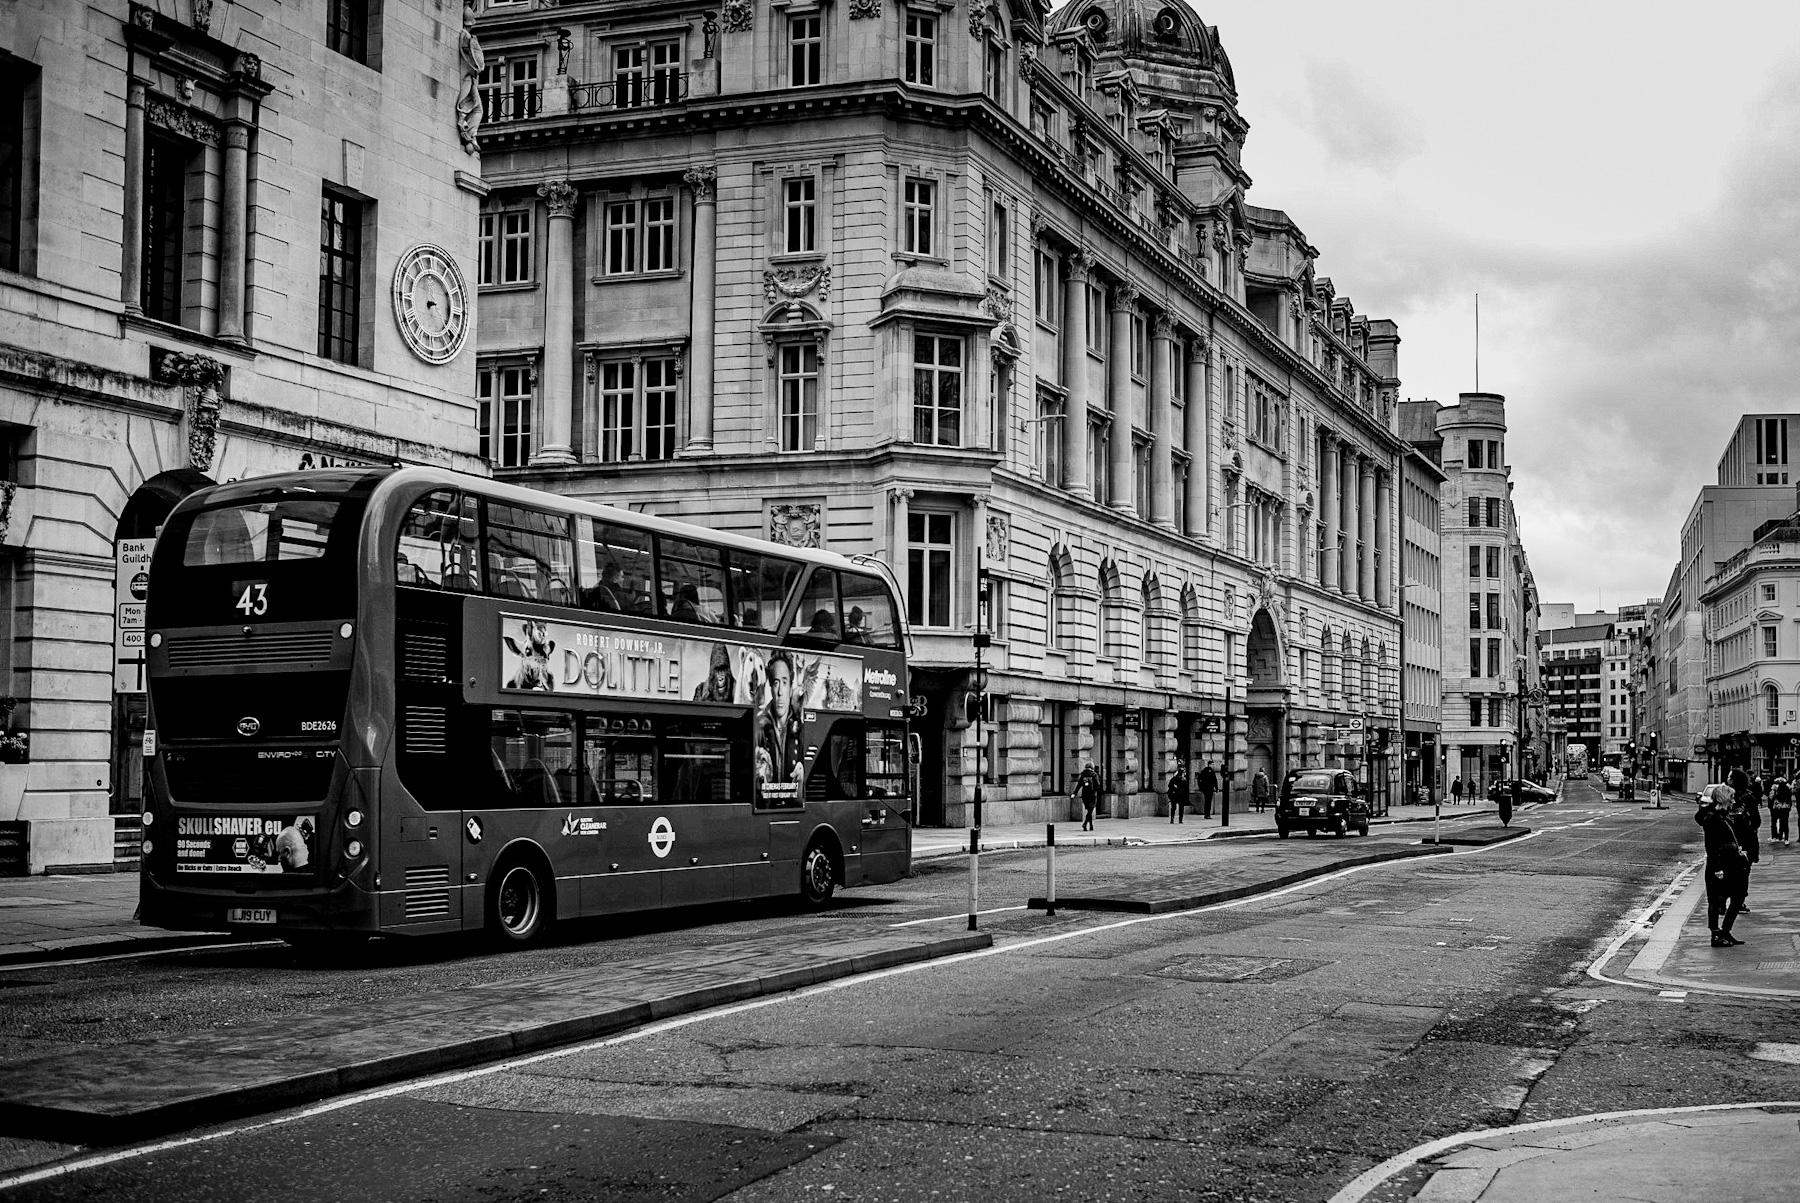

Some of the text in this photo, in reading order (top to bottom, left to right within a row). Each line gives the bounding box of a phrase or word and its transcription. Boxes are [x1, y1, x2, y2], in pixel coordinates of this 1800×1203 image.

[122, 542, 146, 552] Bank
[236, 584, 268, 616] 43
[576, 633, 666, 655] ROBERT DOWNEY JR.
[562, 647, 679, 694] DOLITTLE
[864, 668, 897, 686] Metroline
[301, 720, 337, 731] BDE2626
[178, 818, 282, 835] SKULLSHAVER eu
[177, 840, 212, 849] 90 Seconds
[177, 849, 188, 858] and
[254, 910, 272, 921] CUY
